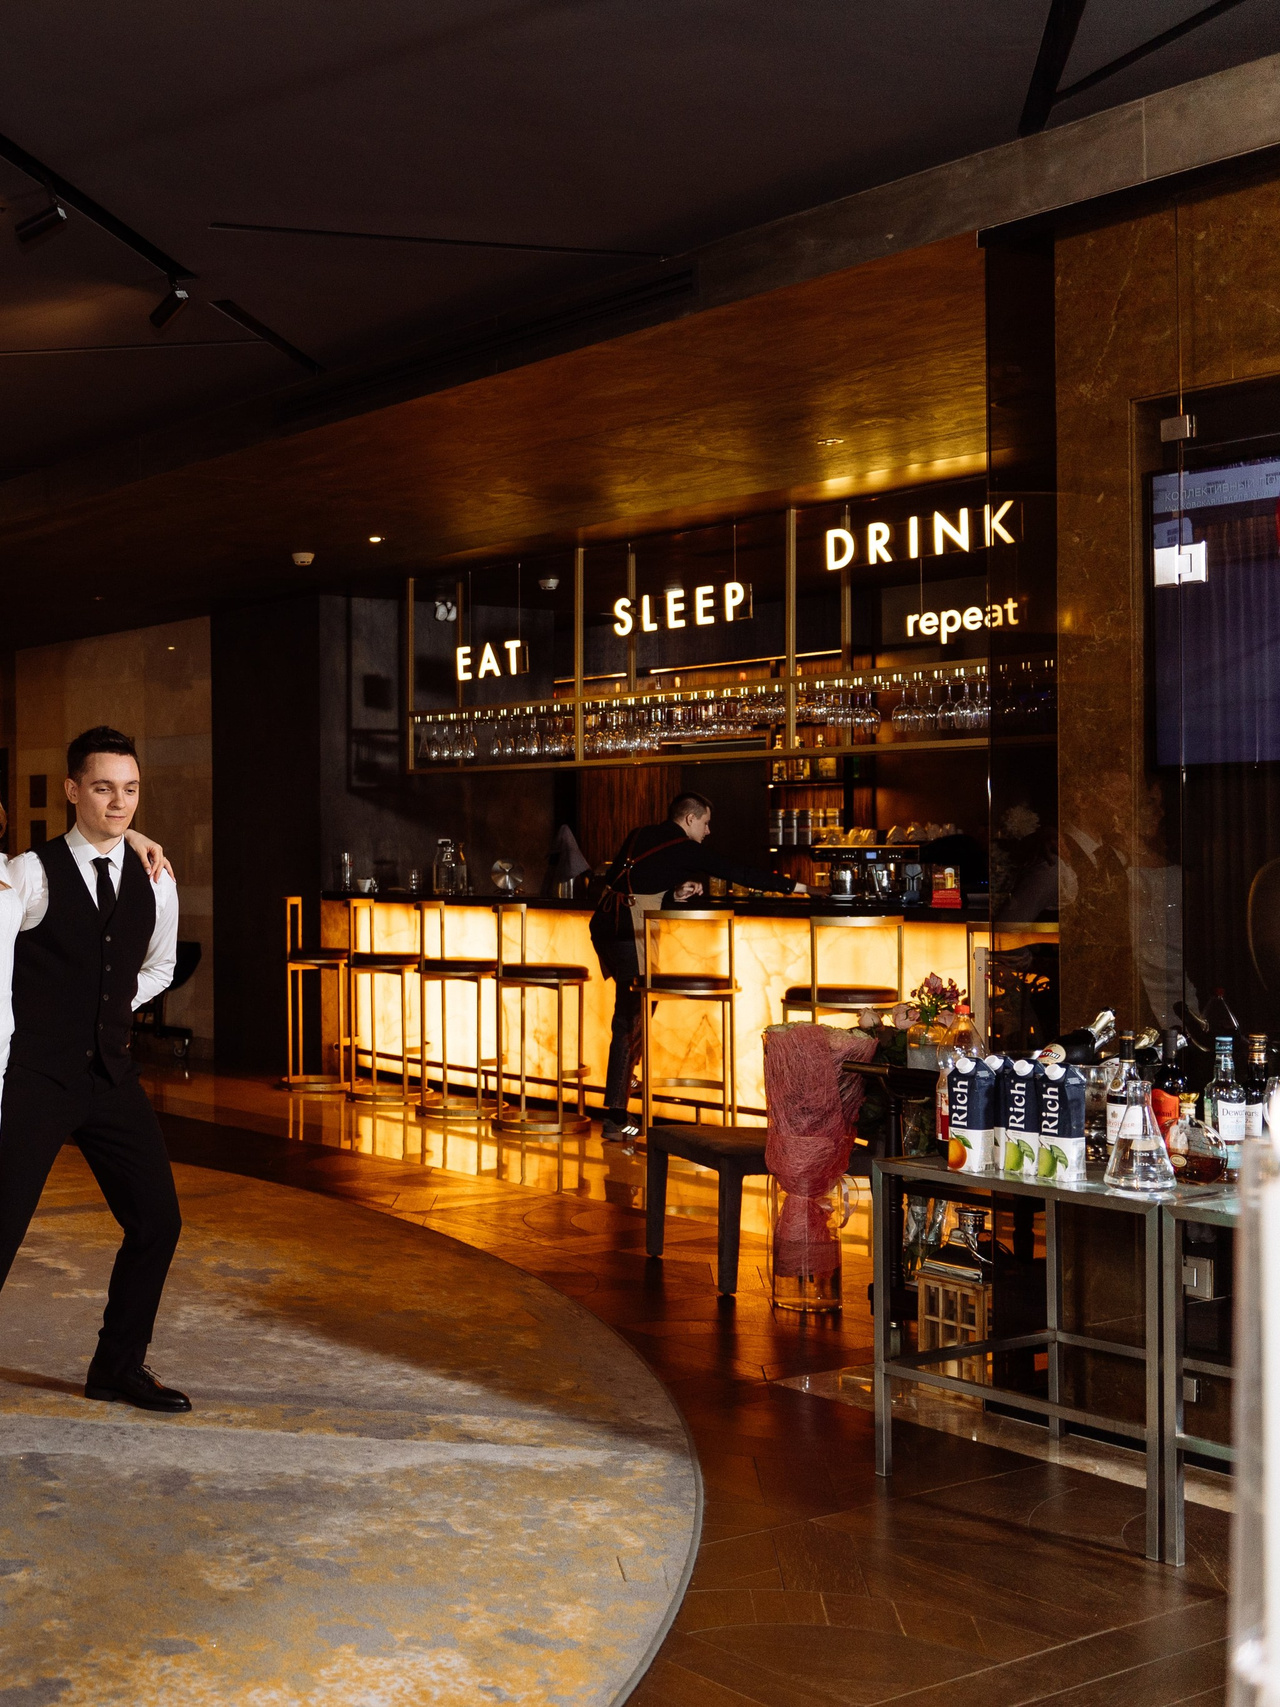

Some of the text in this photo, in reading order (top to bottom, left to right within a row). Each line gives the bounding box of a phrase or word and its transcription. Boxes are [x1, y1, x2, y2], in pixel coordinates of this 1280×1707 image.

[824, 499, 1016, 571] DRINK
[613, 580, 746, 637] SLEEP
[905, 597, 1019, 644] repeat
[455, 638, 523, 682] EAT
[951, 1080, 969, 1126] Rich
[1008, 1082, 1027, 1129] Rich
[1041, 1087, 1059, 1134] Rich
